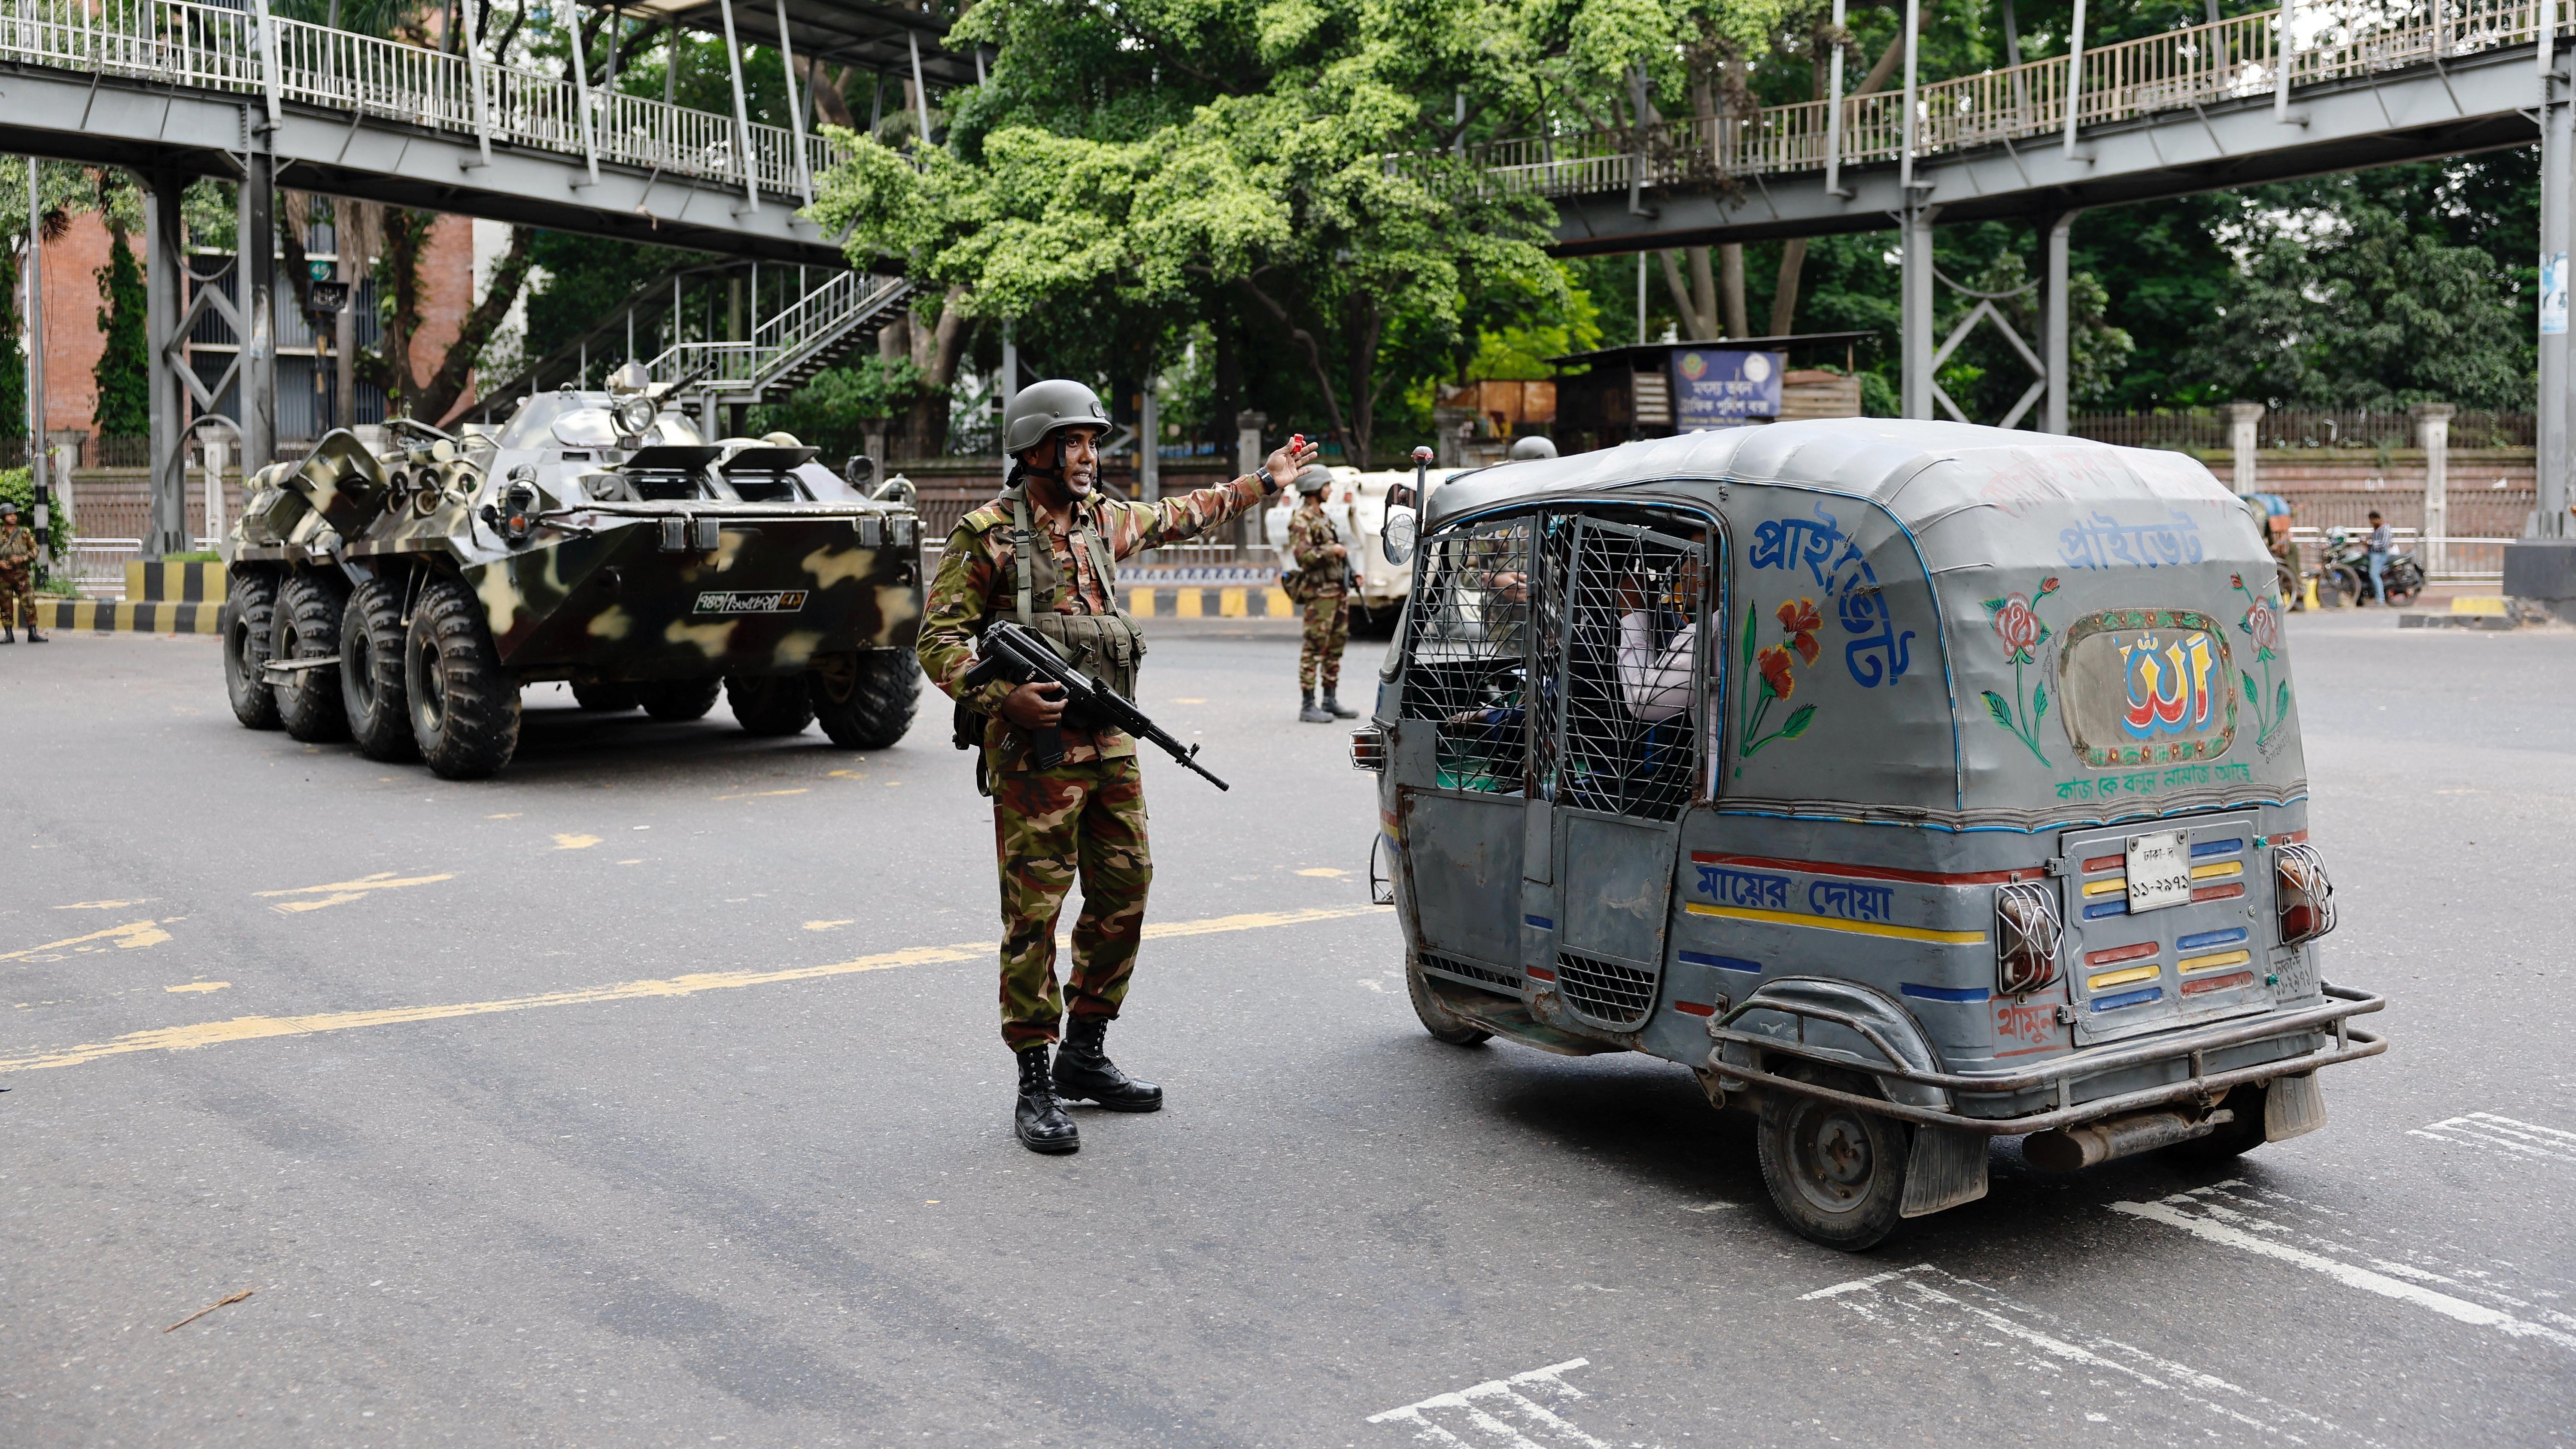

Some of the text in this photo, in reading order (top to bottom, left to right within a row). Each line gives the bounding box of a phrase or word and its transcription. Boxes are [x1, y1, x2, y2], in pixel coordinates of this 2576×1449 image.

[2057, 507, 2202, 572] প্রাইভেট
[1750, 501, 1915, 688] প্রাইভেট
[2055, 776, 2093, 800] কাজ
[2099, 777, 2120, 798] কে
[2123, 772, 2159, 796] বলুন
[2164, 764, 2210, 787] নামাজ
[1695, 866, 1894, 920] মায়ের দোয়া
[2131, 874, 2189, 898] ১১-২৯৭১
[2276, 969, 2310, 995] ১১-২৯৭১
[1998, 1003, 2057, 1044] থামুন
